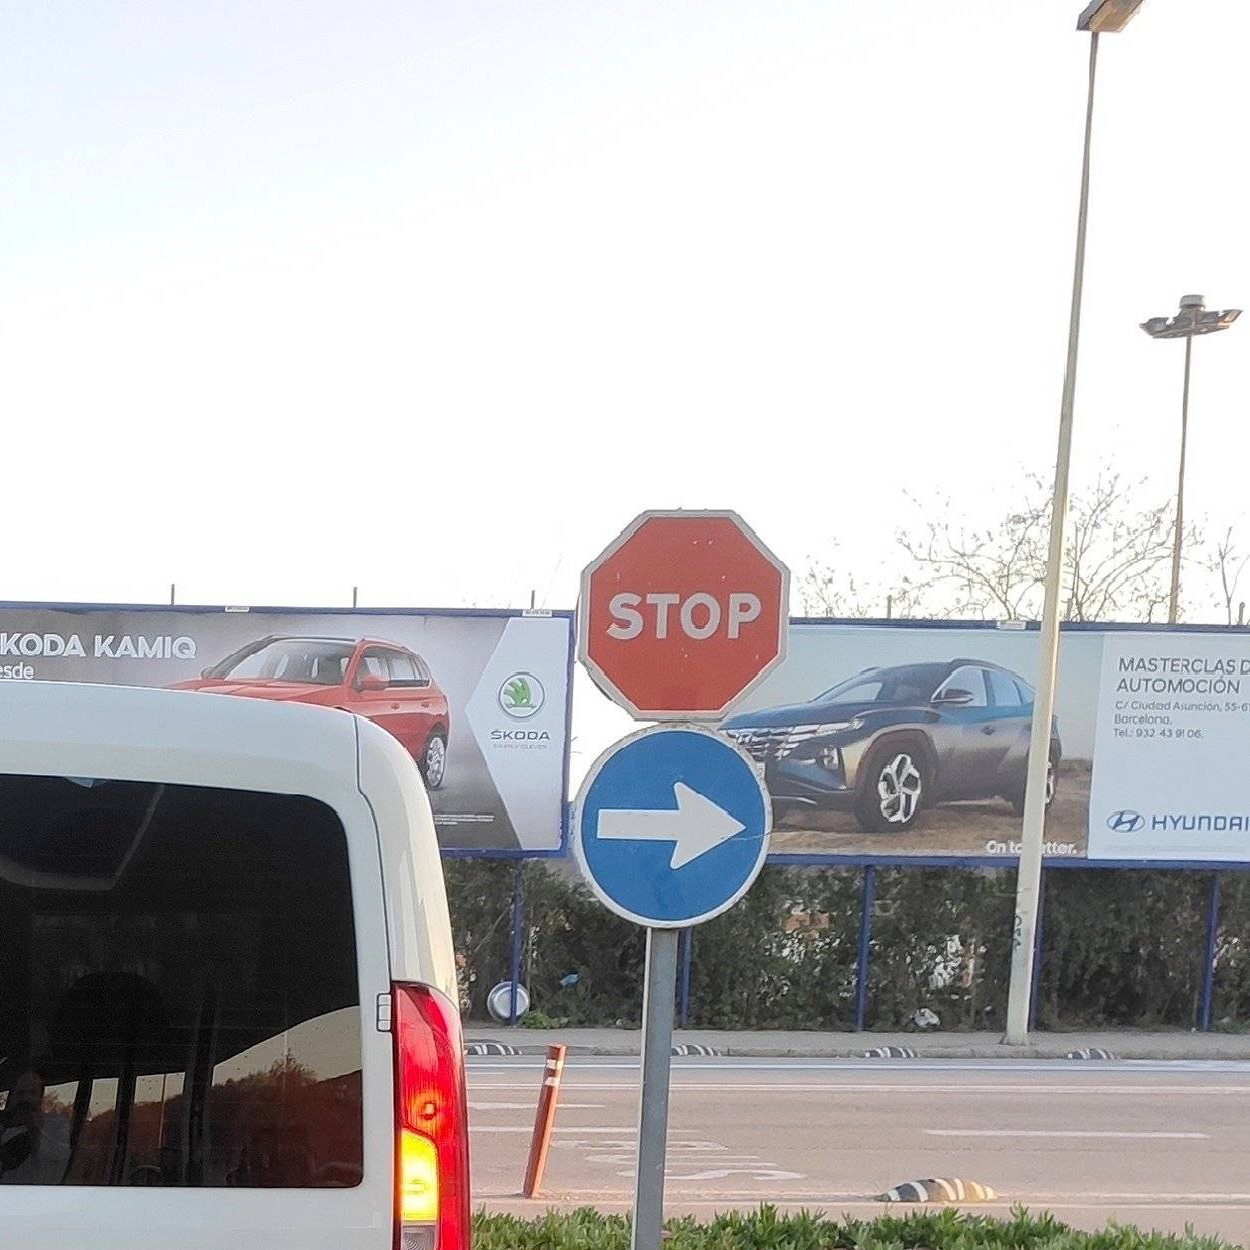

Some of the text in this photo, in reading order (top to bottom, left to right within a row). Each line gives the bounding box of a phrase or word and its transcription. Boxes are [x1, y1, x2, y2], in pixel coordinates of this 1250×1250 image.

[606, 592, 762, 640] STOP
[93, 634, 198, 659] KAMIQ
[1118, 657, 1236, 675] MASTERCLAS
[1116, 676, 1241, 694] AUTOMOCIÓN
[1131, 701, 1171, 711] Ciudad
[1152, 815, 1250, 832] HYUNDAI
[986, 840, 1006, 855] On
